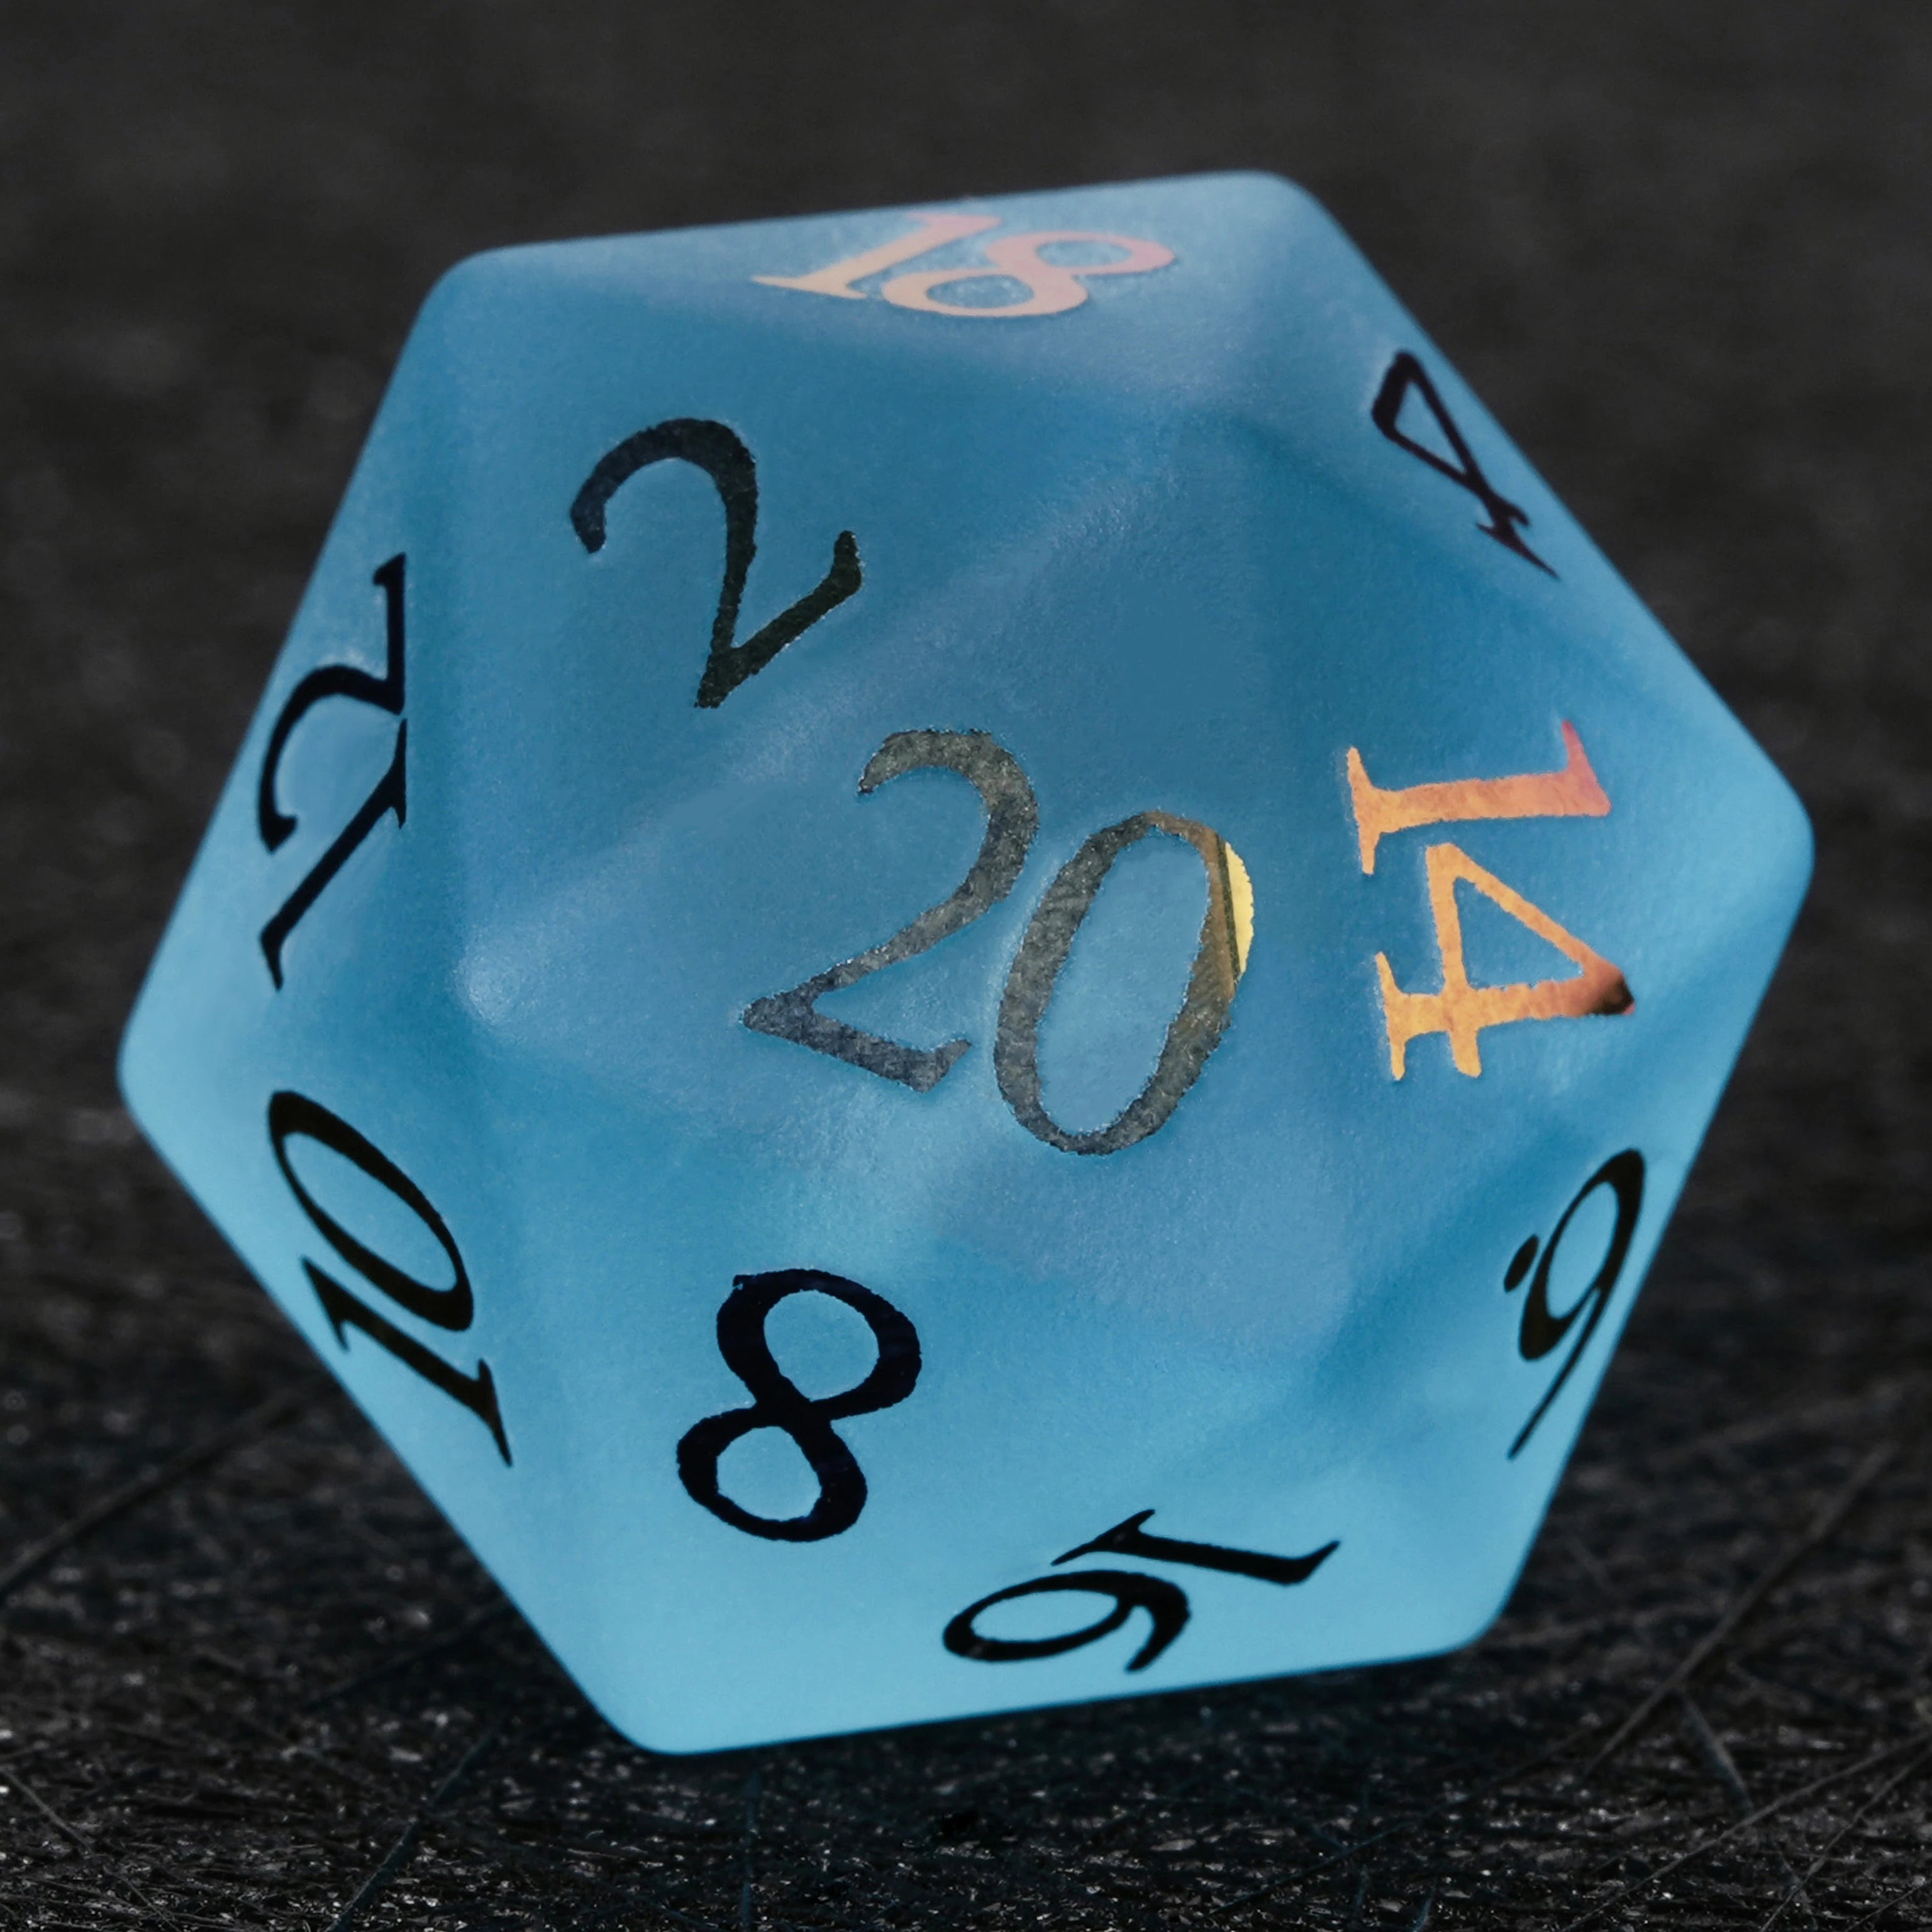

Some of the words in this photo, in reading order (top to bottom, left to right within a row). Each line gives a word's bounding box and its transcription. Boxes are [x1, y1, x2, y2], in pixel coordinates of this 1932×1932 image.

[750, 212, 1175, 318] 18
[570, 416, 863, 708] 2
[1372, 350, 1560, 578] 4
[258, 552, 407, 992] 12
[1346, 719, 1635, 1080] 14
[742, 727, 1255, 1155] 20
[267, 1090, 513, 1467] 10
[676, 1268, 922, 1542] 8
[942, 1509, 1341, 1672] 16
